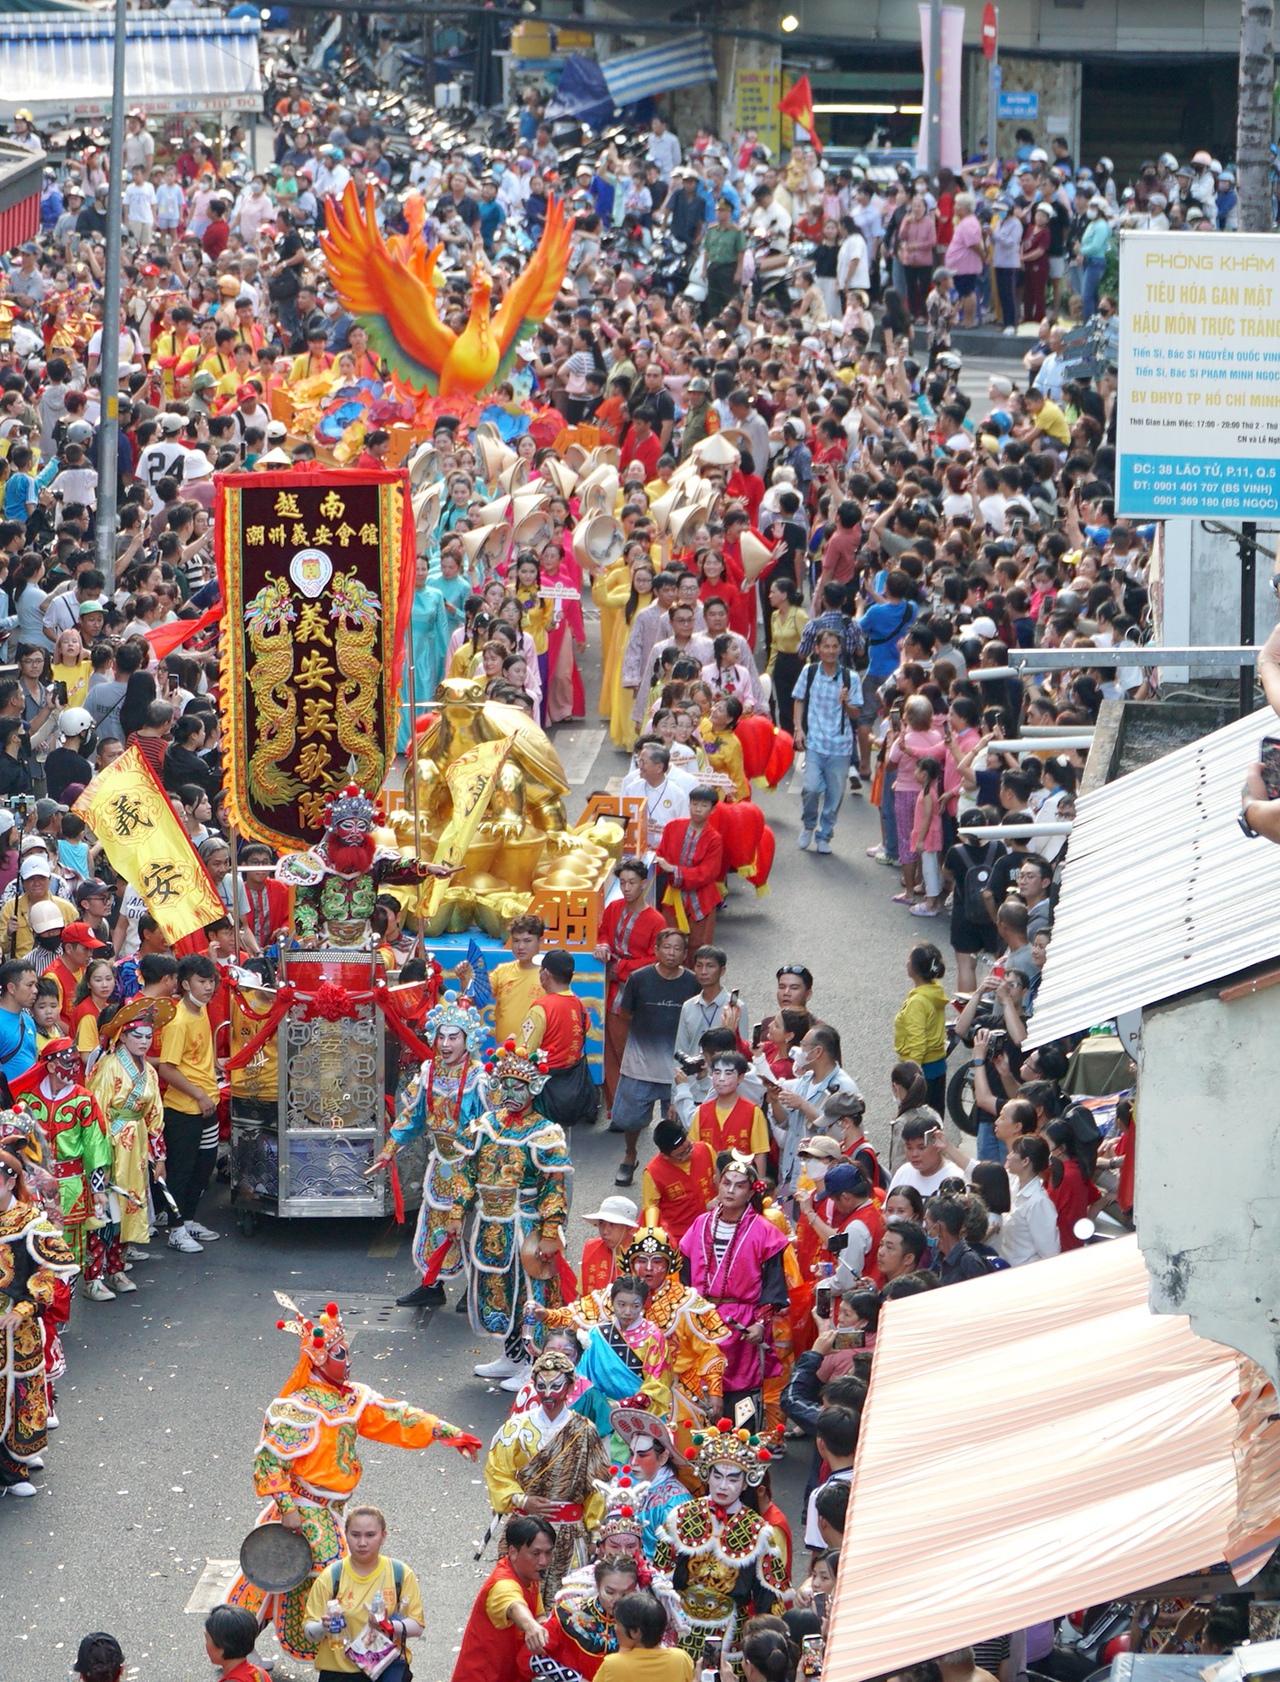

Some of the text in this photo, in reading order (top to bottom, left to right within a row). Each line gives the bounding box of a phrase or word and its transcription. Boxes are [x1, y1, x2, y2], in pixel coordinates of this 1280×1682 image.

[1146, 250, 1275, 272] PHÒNG KHÁM
[1146, 281, 1273, 310] TIÊU HÓA GAN MẬT
[1132, 311, 1160, 338] HẬU
[1165, 312, 1196, 335] MÔN
[1201, 316, 1235, 340] TRỰC
[1236, 349, 1260, 362] QUỐC
[1229, 370, 1254, 380] MINH
[1131, 391, 1147, 403] BV
[1150, 391, 1182, 405] ĐHYD
[1186, 392, 1201, 405] TP
[1225, 391, 1246, 407] CHÍ
[1197, 420, 1215, 428] 17:00
[1221, 421, 1240, 429] 20:00
[1237, 435, 1247, 443] CN
[148, 452, 185, 486] 24
[1133, 462, 1276, 479] ĐC: 38 LÃO TỬ, P.11, Q.5
[1133, 480, 1272, 496] ĐT: 0901 401 707 (BS VINH)
[1153, 496, 1278, 510] 0901 369 180 (BS NGỌC)
[293, 602, 338, 832] 義安英歌隊
[111, 795, 183, 905] 義安
